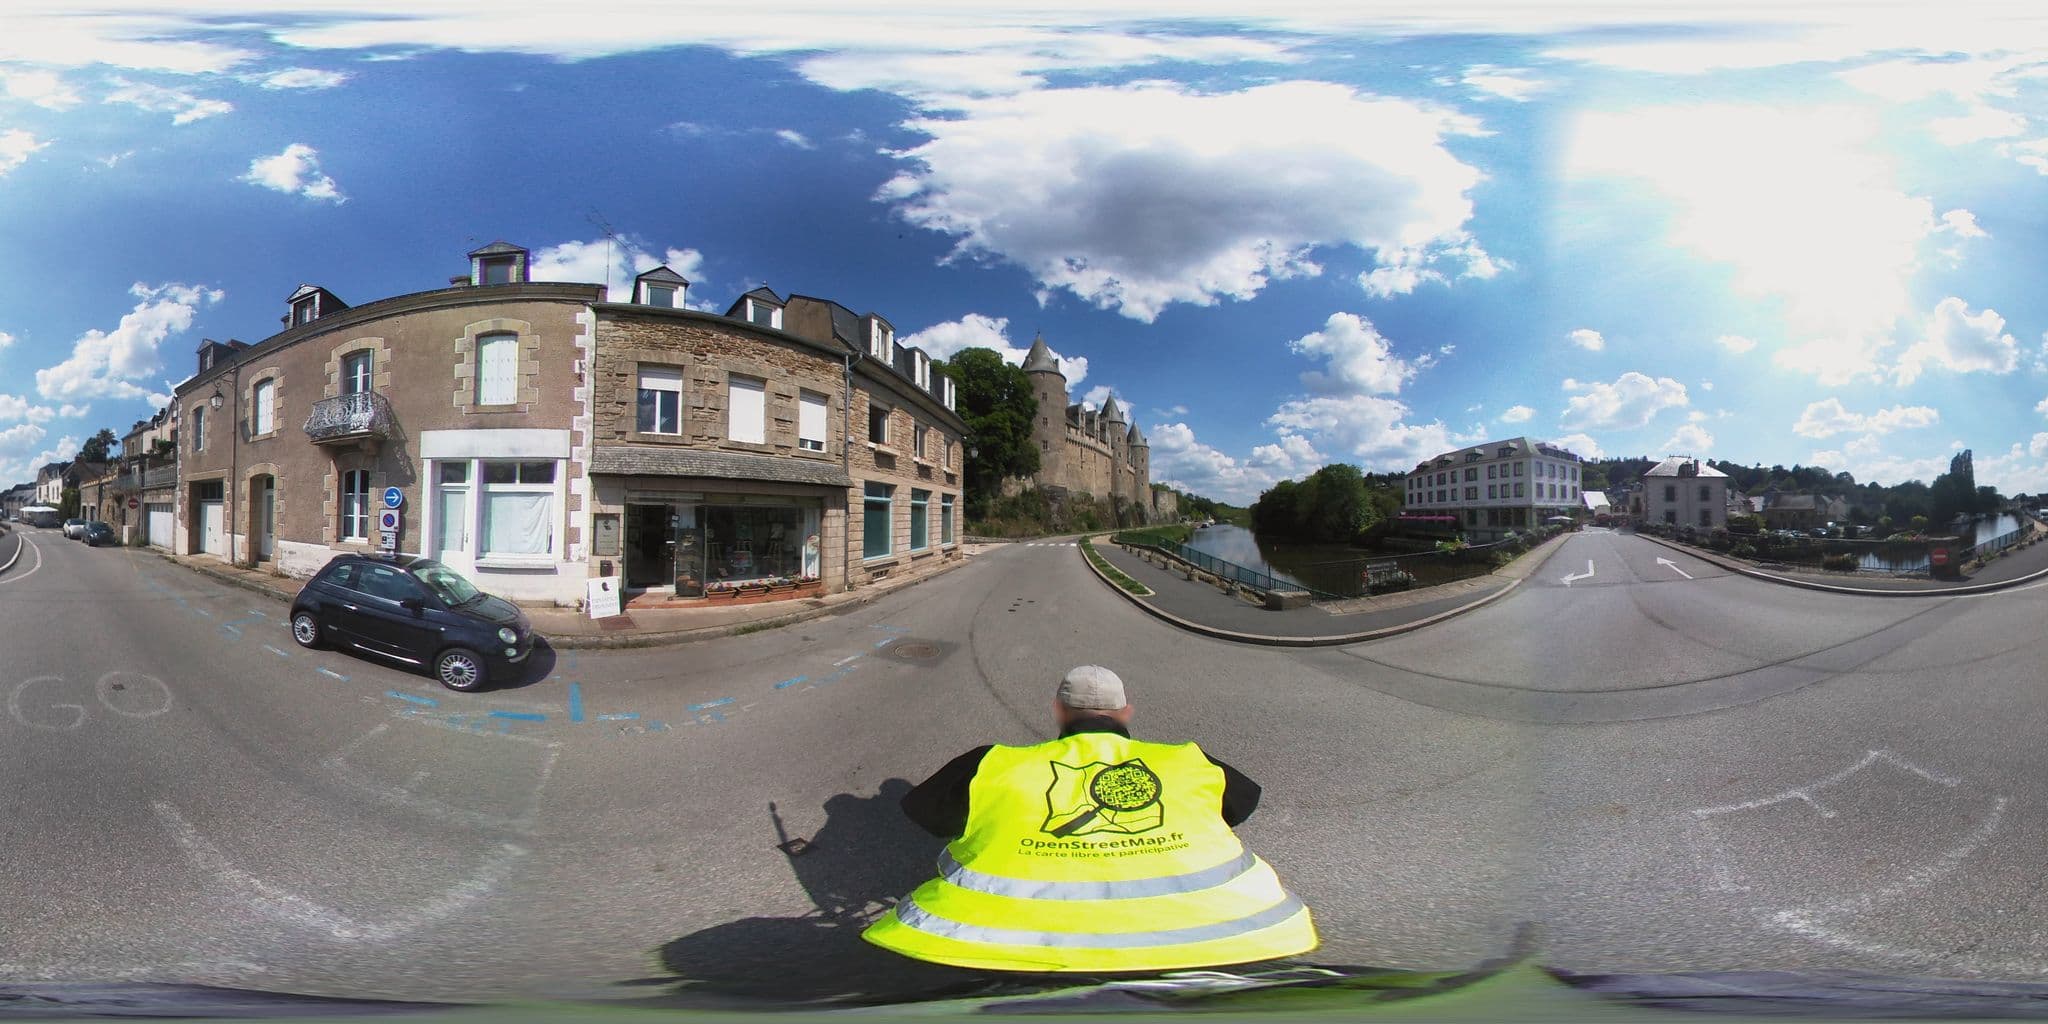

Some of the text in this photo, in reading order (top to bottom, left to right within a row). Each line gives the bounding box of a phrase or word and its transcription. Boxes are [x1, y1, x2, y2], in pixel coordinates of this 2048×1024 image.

[8, 671, 173, 729] GO
[1021, 832, 1184, 849] OpenStreetMap.fr
[1036, 850, 1067, 858] carte
[1119, 842, 1189, 857] participative
